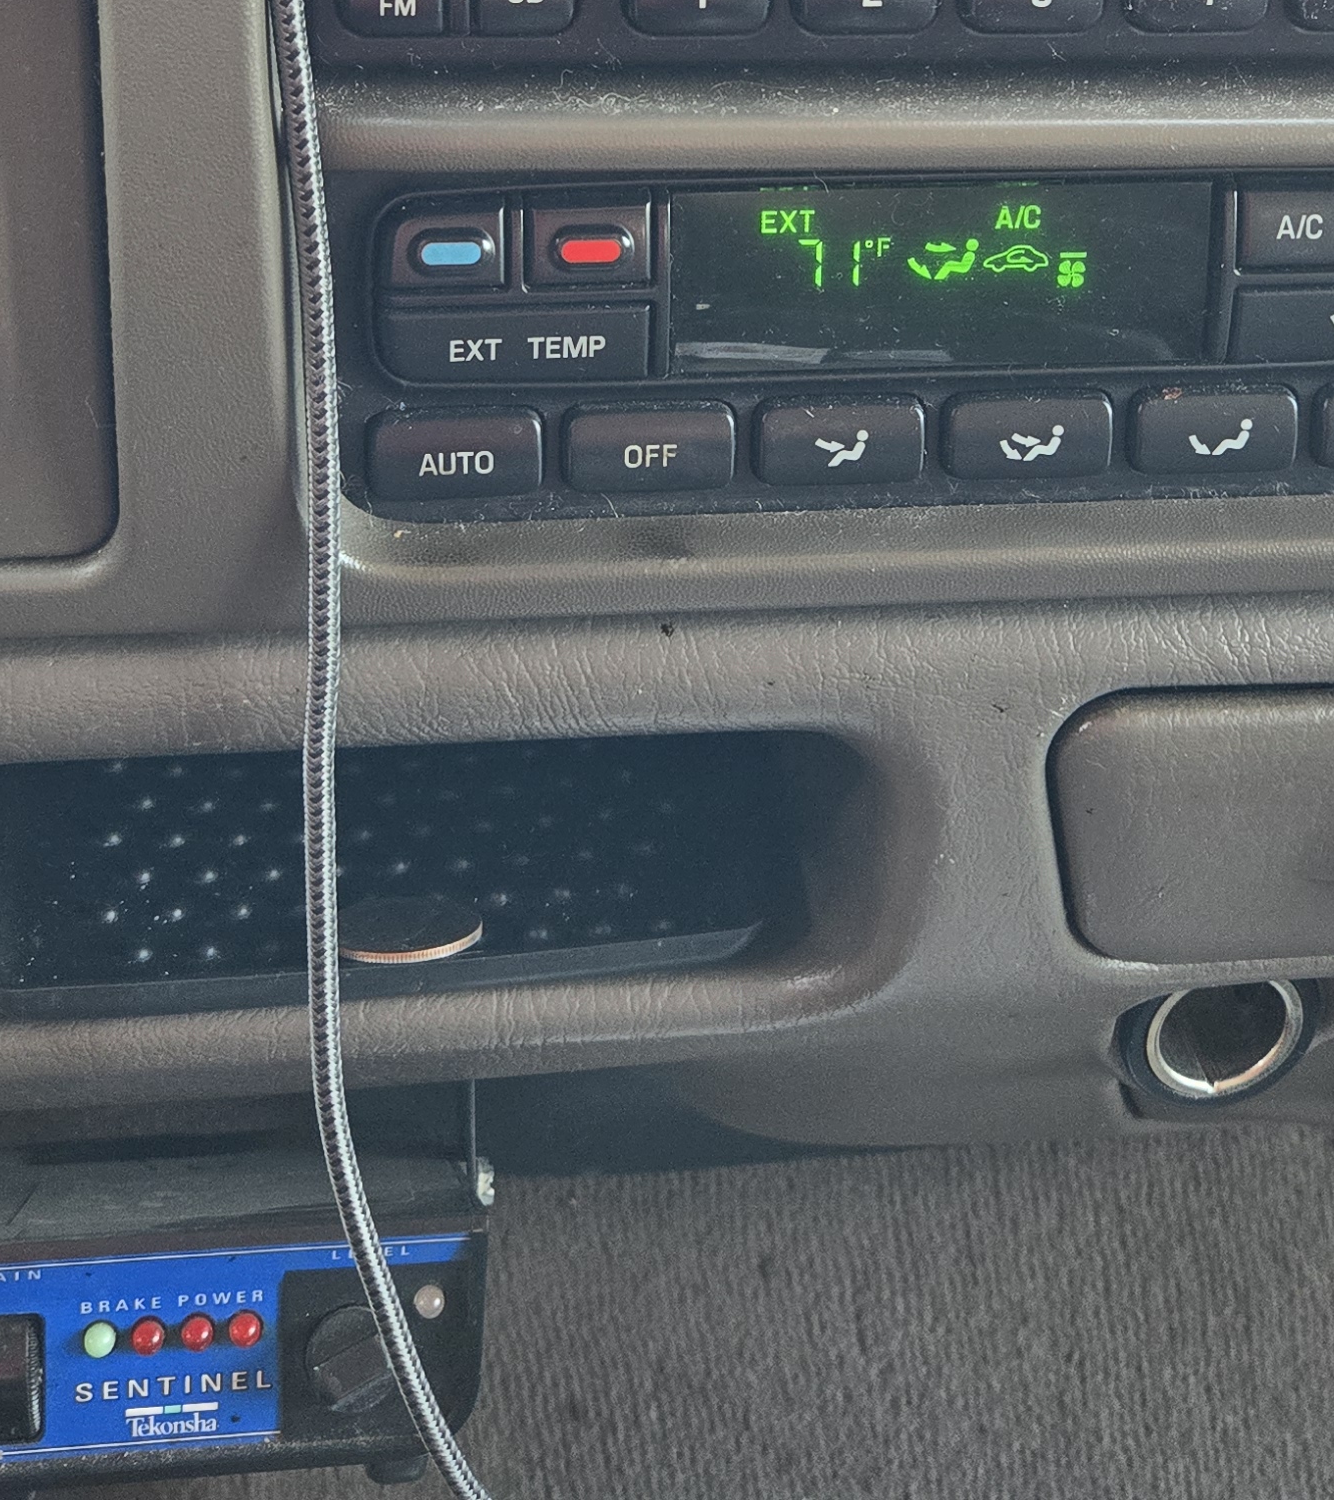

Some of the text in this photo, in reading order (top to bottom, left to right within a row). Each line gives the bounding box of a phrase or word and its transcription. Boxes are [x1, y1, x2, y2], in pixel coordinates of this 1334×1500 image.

[759, 208, 817, 235] EXT
[993, 204, 1043, 231] A/C
[1276, 213, 1324, 241] A/C
[448, 334, 607, 364] EXT TEMP
[418, 449, 496, 478] AUTO
[622, 441, 678, 470] OFF
[331, 1244, 411, 1262] LEL
[79, 1288, 265, 1316] BRAKE POWER
[74, 1369, 273, 1404] SENTINEL
[125, 1411, 219, 1438] Tekonsha
